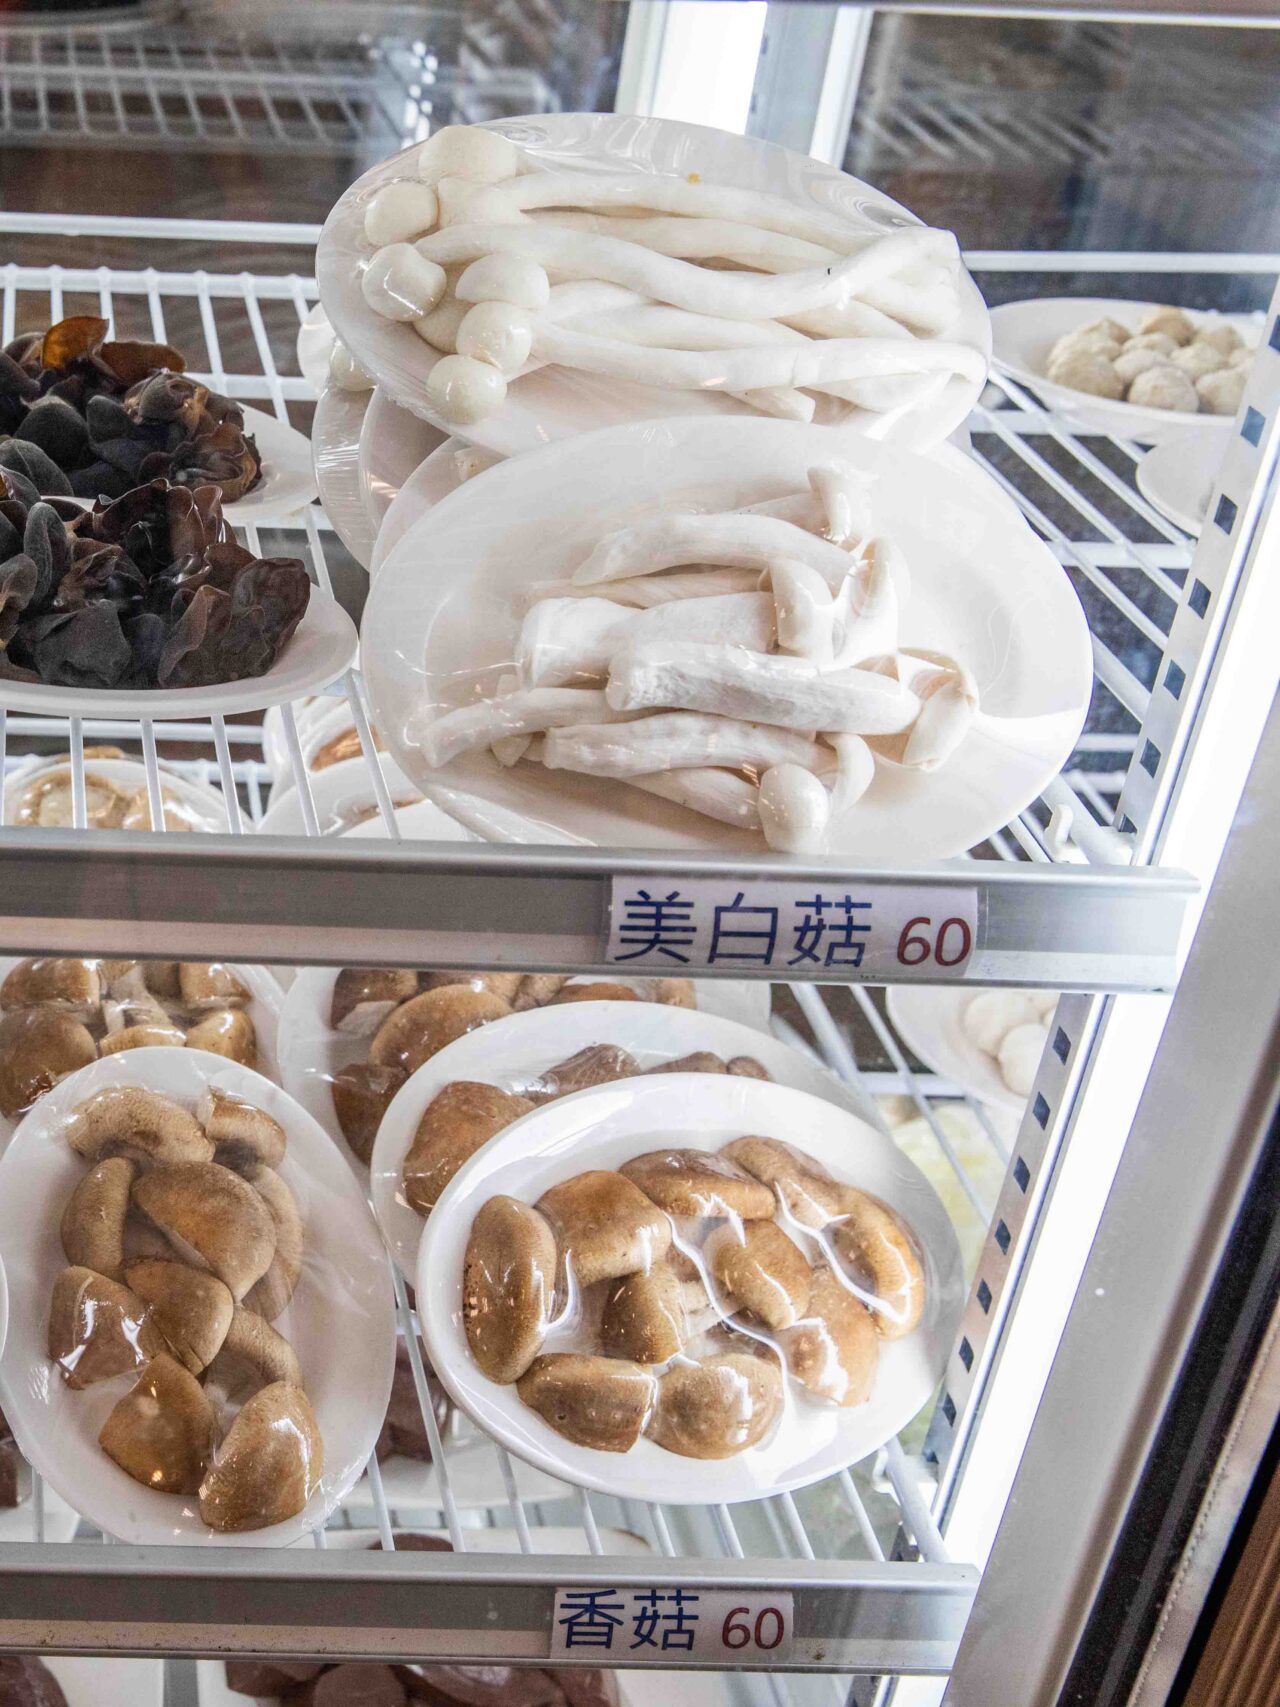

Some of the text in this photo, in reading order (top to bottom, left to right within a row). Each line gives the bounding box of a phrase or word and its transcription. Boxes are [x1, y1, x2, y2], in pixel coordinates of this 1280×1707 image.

[614, 889, 972, 968] 美白菇 60
[558, 1589, 785, 1651] 香菇 60
